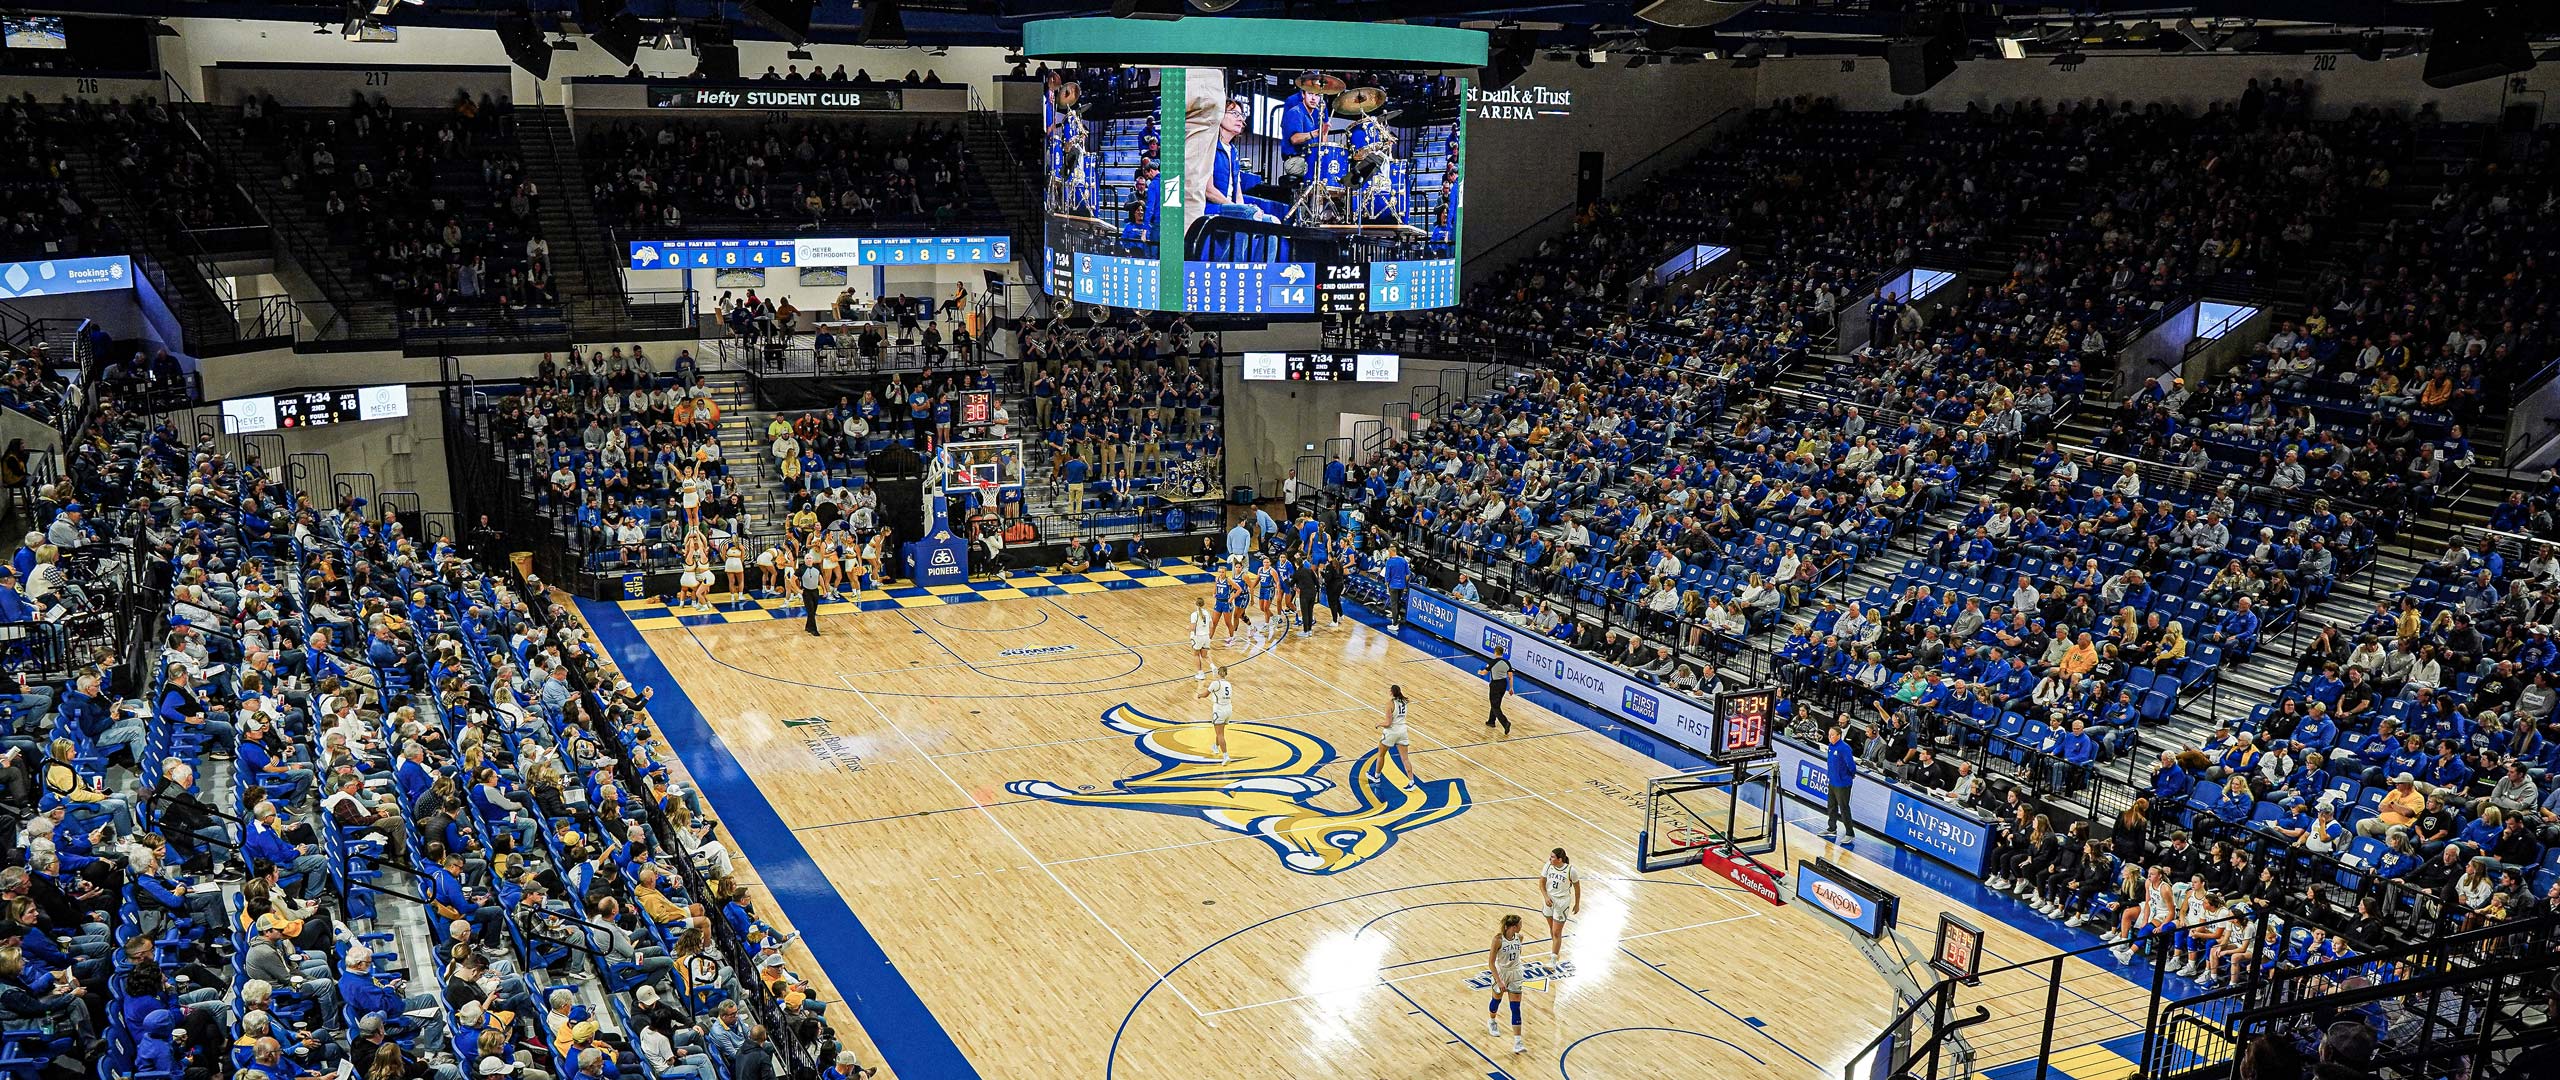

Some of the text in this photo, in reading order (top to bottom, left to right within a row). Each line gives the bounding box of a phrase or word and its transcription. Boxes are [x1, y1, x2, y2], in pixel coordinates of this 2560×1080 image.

[2314, 54, 2336, 70] 202
[76, 78, 98, 94] 216
[365, 72, 388, 86] 217
[696, 90, 860, 107] Hefty STUDENT CLUB
[1481, 86, 1520, 104] Bank
[1522, 90, 1533, 104] &
[1534, 86, 1570, 105] Trust
[767, 111, 788, 124] 218
[1479, 106, 1534, 120] ARENA
[668, 252, 790, 265] 0 4 8 4 5
[867, 249, 980, 261] 0 3 8 5 2
[1055, 252, 1069, 266] 7:34
[68, 269, 109, 279] Brookings
[1327, 266, 1360, 279] 7:34
[1080, 278, 1094, 294] 18
[1380, 286, 1399, 302] 18
[1280, 288, 1305, 304] 14
[1322, 293, 1328, 301] 0
[1359, 293, 1365, 301] 0
[1341, 363, 1354, 371] 18
[304, 393, 331, 404] 7:34
[969, 394, 988, 403] 7:34
[280, 400, 356, 416] 14 18
[371, 404, 396, 412] MEYER
[966, 404, 986, 420] 30
[624, 581, 634, 593] UP
[633, 576, 644, 598] EARS
[1412, 596, 1454, 623] SANFORD
[1418, 614, 1444, 630] HEALTH
[1491, 631, 1510, 647] FIRST
[1526, 650, 1605, 694] FIRST DAKOTA
[1225, 687, 1229, 696] 5
[1399, 703, 1405, 714] 12
[1633, 693, 1656, 710] FIRST
[1737, 697, 1768, 714] 7:34
[1632, 702, 1655, 720] DAKOTA
[1677, 714, 1710, 739] FIRST
[1729, 716, 1761, 748] 30
[1810, 782, 1829, 795] DAKO
[1895, 802, 1975, 847] SANFORD
[1908, 828, 1956, 855] HEALTH
[1549, 872, 1566, 882] STATE
[1552, 881, 1558, 889] 21
[1816, 884, 1858, 914] LARSON
[1503, 944, 1520, 952] STATE
[1509, 953, 1516, 961] 13
[1861, 946, 1888, 974] LEGACY
